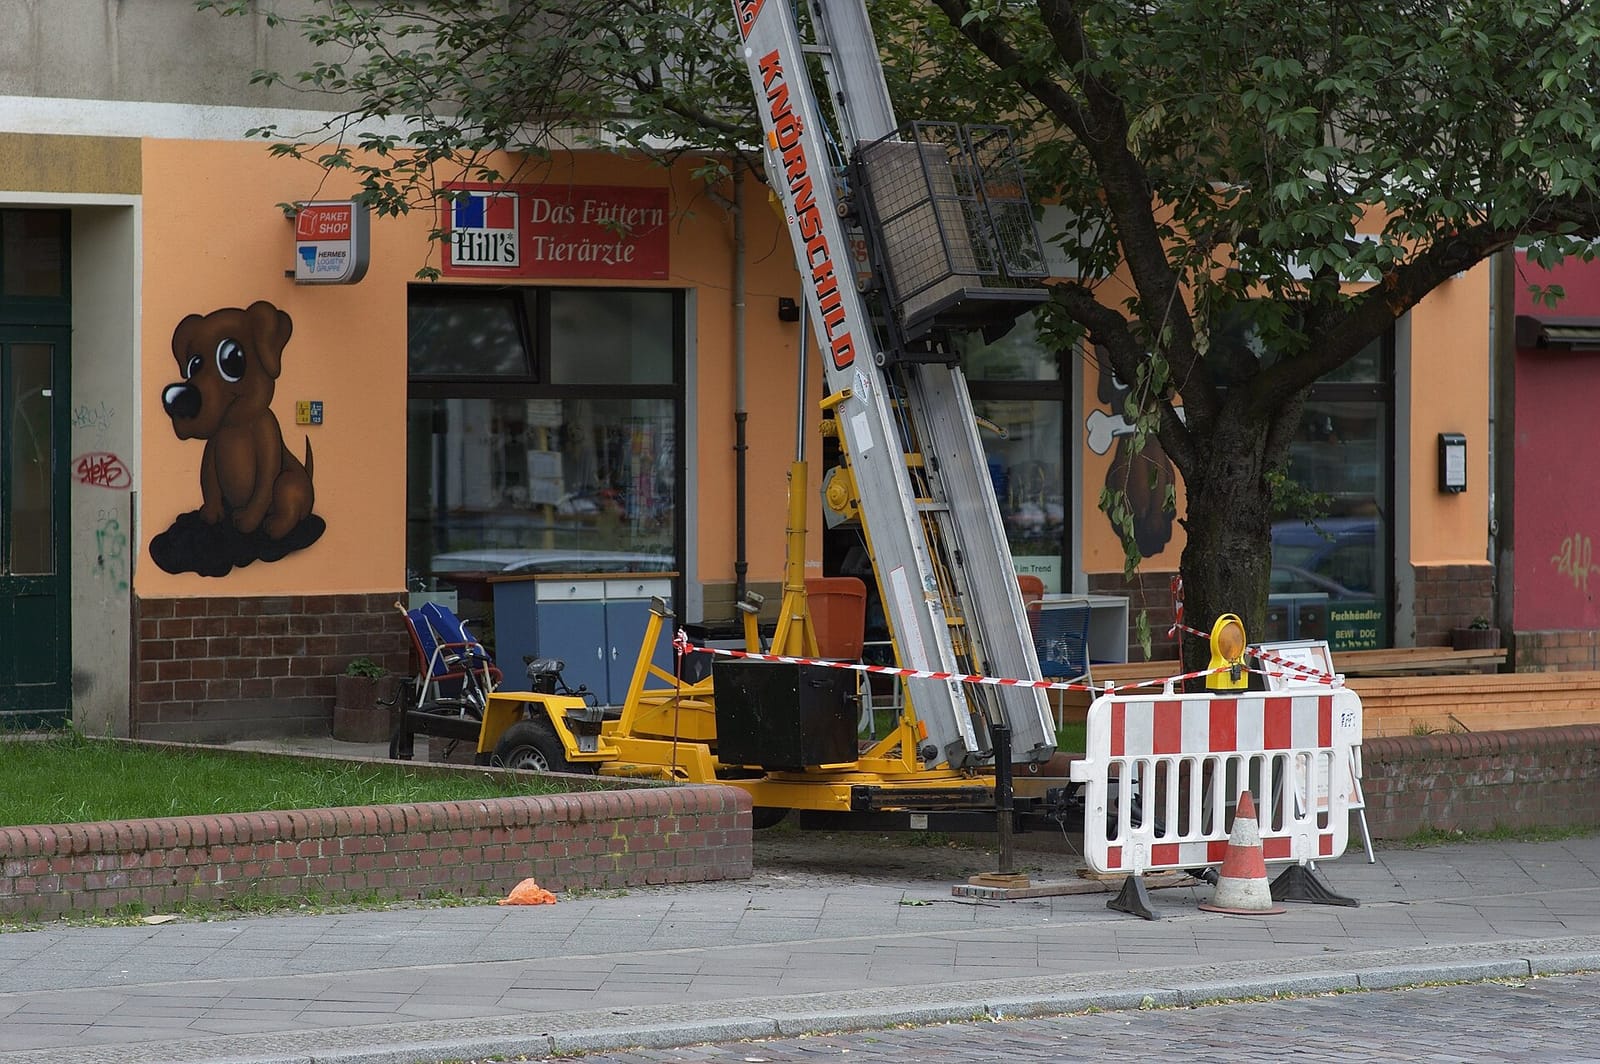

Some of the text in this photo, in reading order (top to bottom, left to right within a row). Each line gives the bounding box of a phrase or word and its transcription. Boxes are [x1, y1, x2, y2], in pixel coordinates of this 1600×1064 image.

[531, 198, 664, 227] Das Füttern
[758, 48, 857, 371] KNÖRNSCHILD
[319, 211, 349, 221] PAKET
[319, 223, 348, 234] SHOP
[532, 236, 635, 265] Tierärzte
[1020, 564, 1029, 572] im
[1031, 564, 1052, 573] Trend
[1331, 610, 1381, 621] Fachhändler
[1359, 630, 1376, 638] DOG
